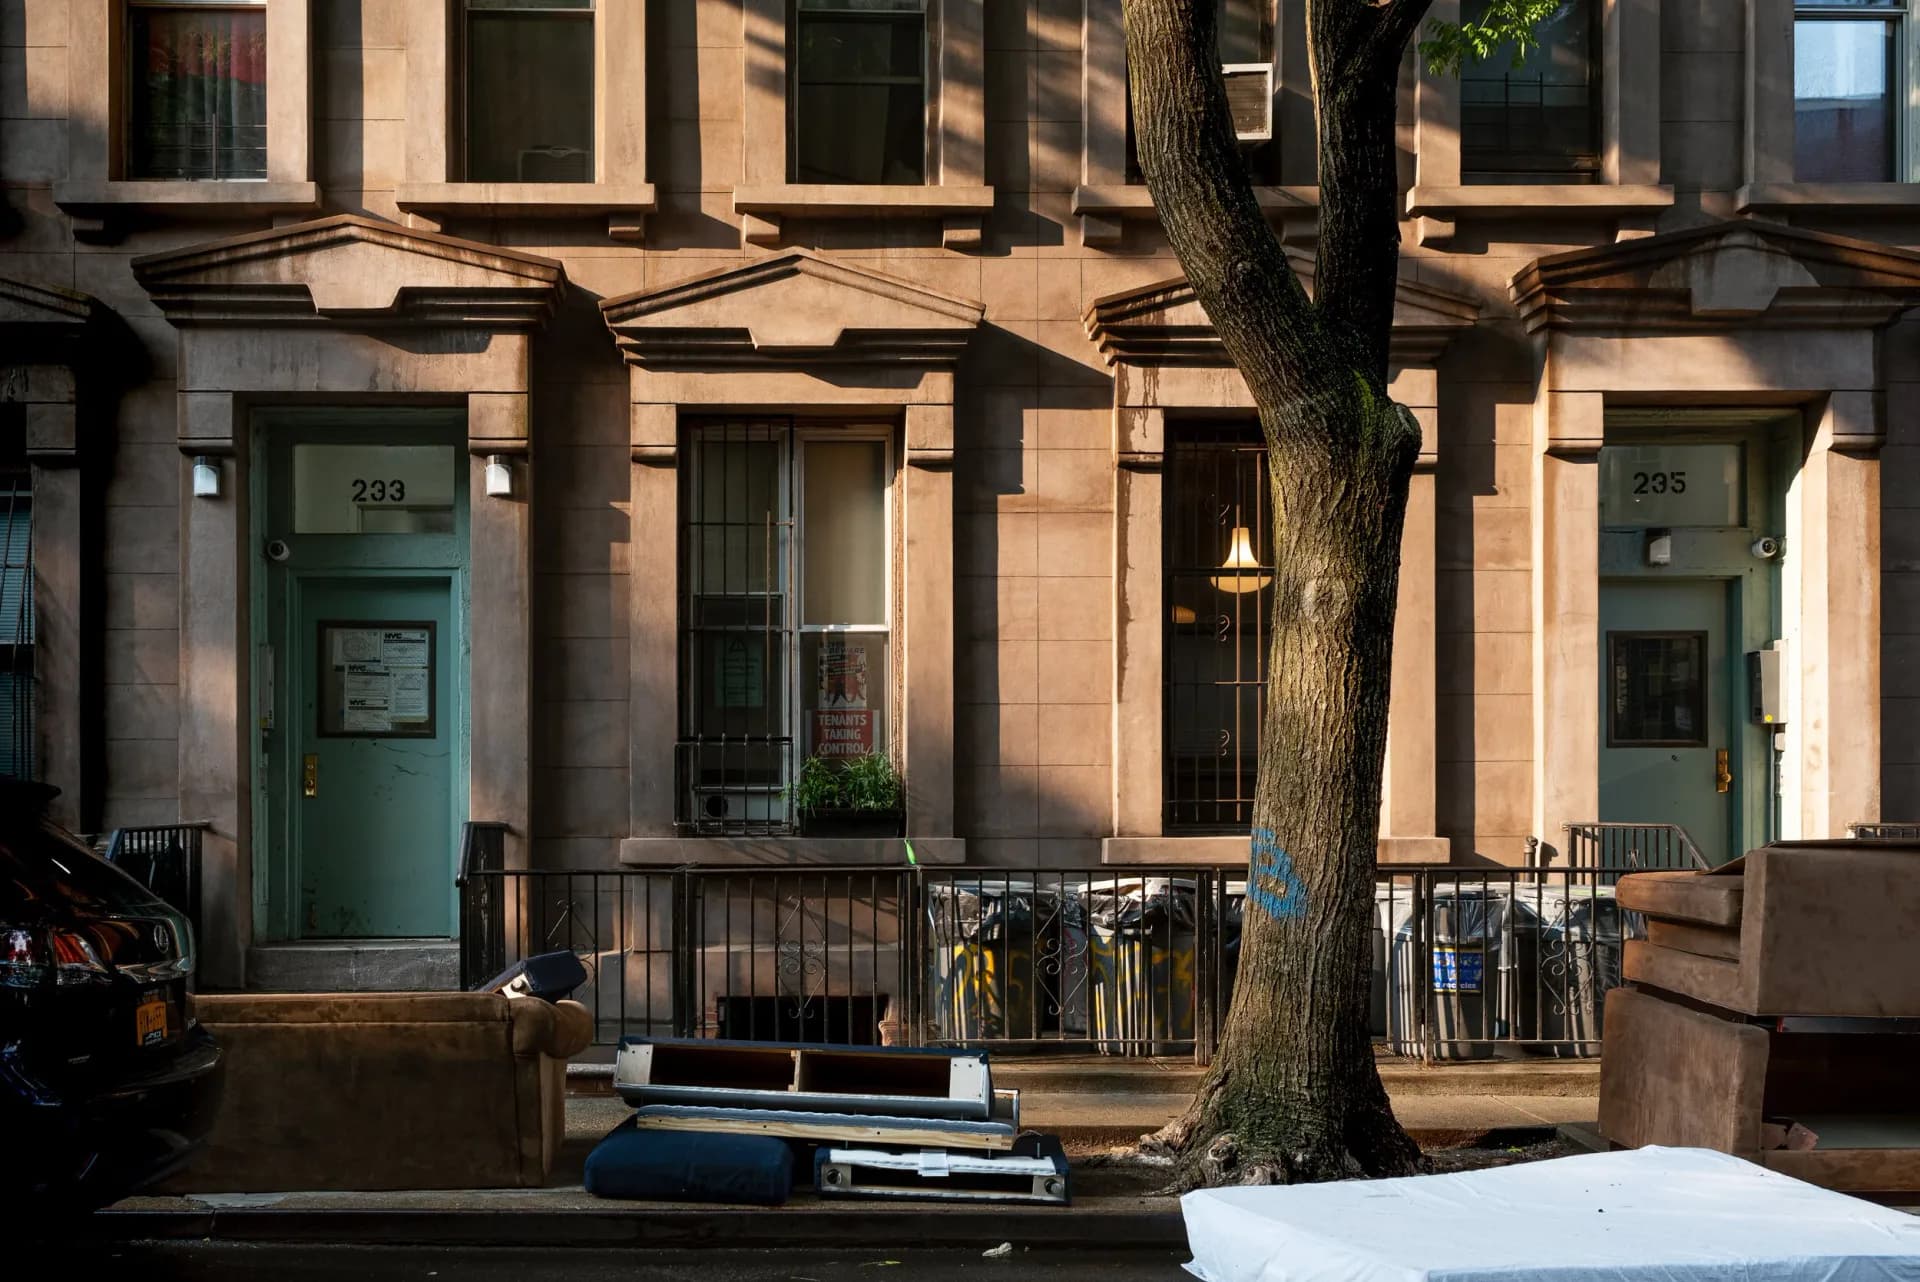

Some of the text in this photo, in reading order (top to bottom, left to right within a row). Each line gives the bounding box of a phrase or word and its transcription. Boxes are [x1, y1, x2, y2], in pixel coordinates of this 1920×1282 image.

[1633, 471, 1686, 495] 235
[351, 479, 405, 502] 233
[818, 714, 867, 726] TENANTS
[823, 728, 861, 740] TAKING
[818, 743, 866, 754] CONTROL
